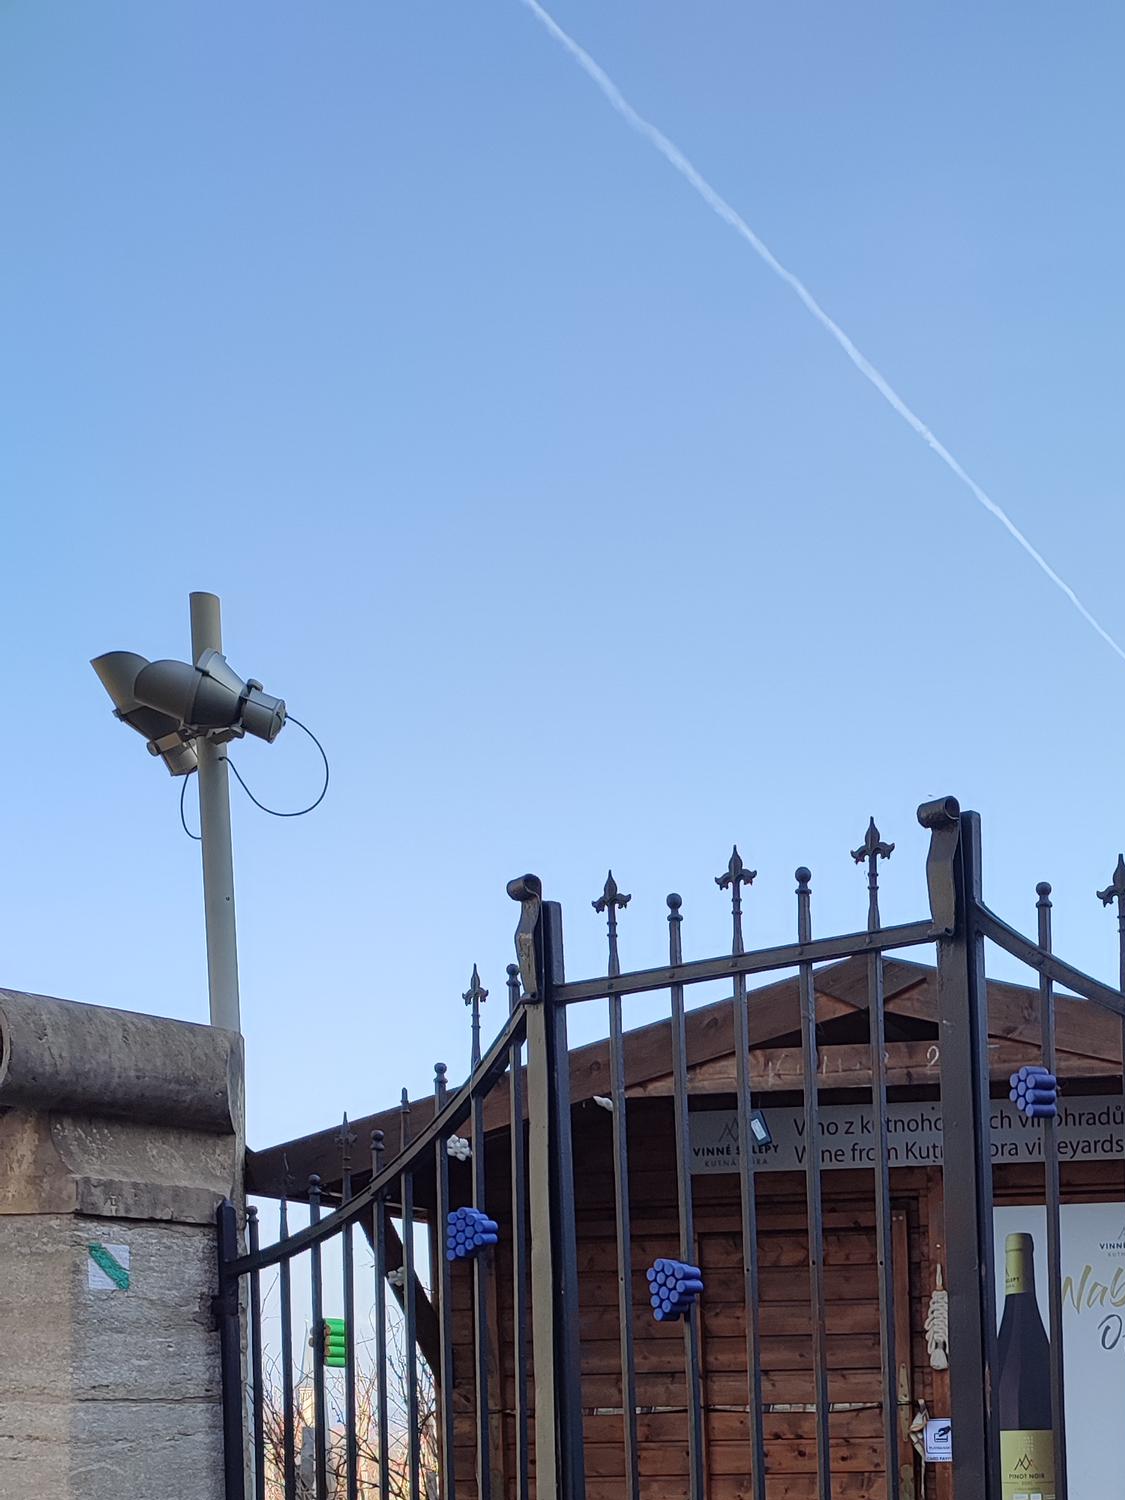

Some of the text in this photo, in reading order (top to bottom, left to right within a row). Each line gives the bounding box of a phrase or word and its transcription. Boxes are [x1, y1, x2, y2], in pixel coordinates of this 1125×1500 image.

[793, 1118, 839, 1137] Vno
[844, 1120, 855, 1135] z
[1018, 1105, 1124, 1130] viohradů
[693, 1143, 779, 1157] VINNÉ SLEPY
[794, 1144, 846, 1164] Wne
[1027, 1134, 1124, 1159] vieyards
